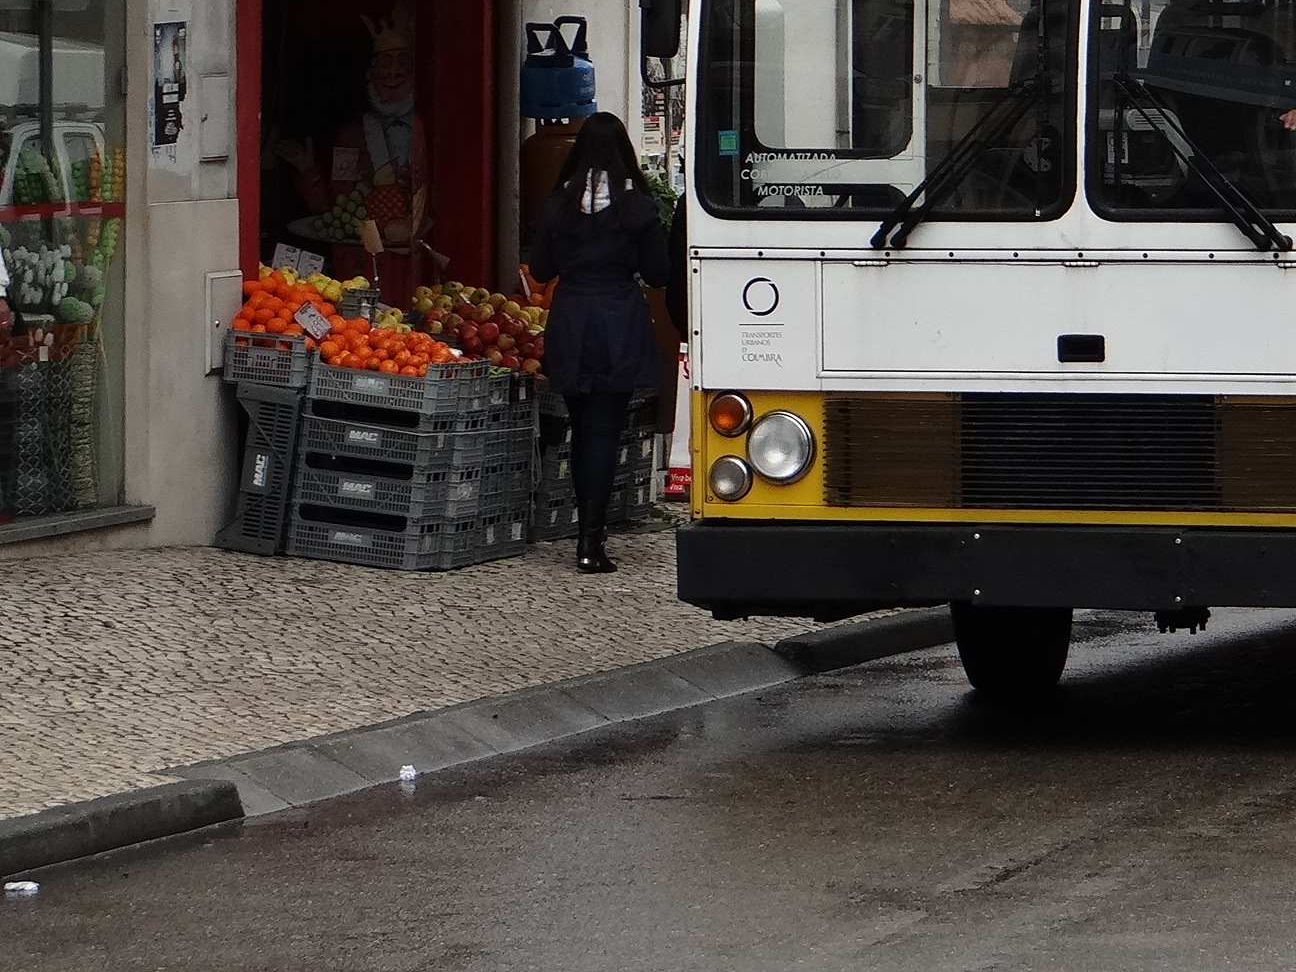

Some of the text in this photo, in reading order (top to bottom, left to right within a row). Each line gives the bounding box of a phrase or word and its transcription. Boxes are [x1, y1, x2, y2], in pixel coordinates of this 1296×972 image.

[745, 152, 836, 164] AUTOMATIZADA
[757, 185, 825, 196] MOTORISTA
[741, 353, 783, 368] COIMBRA
[349, 430, 379, 443] MAC
[252, 453, 267, 488] MAC
[342, 481, 373, 494] MAC
